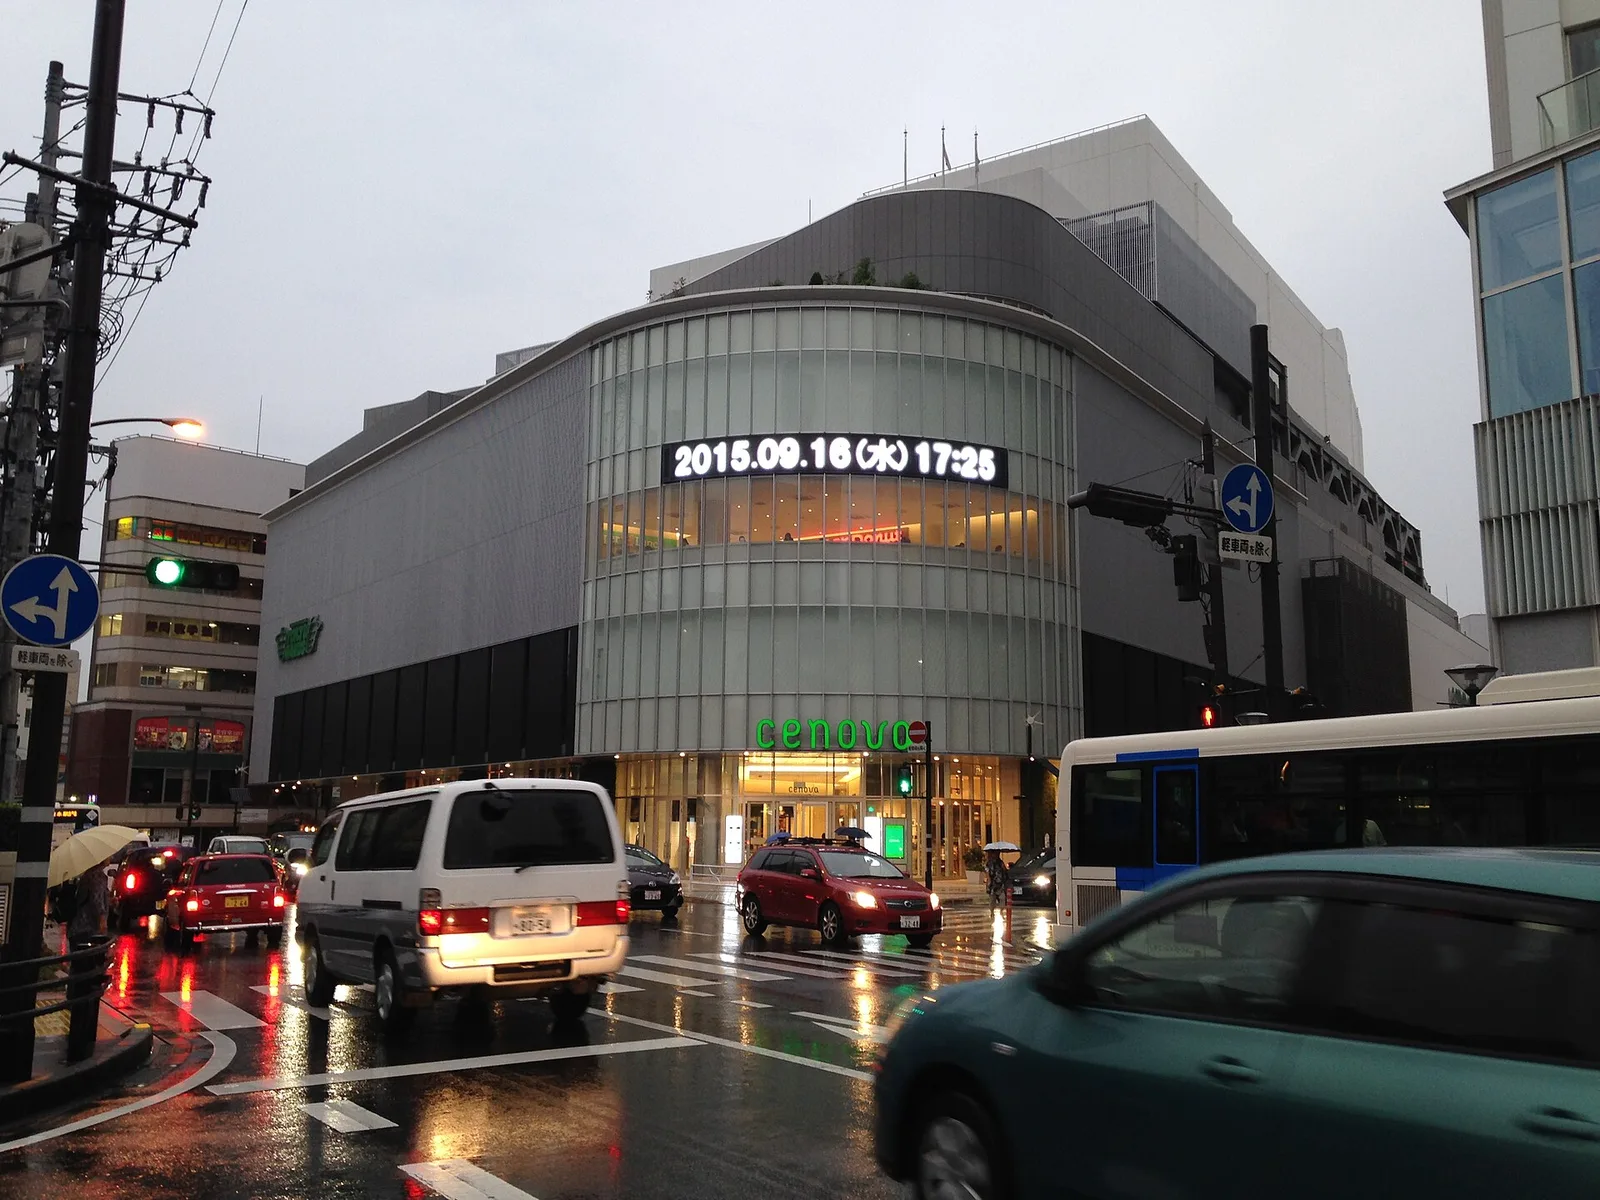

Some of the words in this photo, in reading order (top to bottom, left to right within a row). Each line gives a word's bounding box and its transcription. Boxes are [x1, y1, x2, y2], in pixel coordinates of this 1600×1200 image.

[674, 437, 909, 478] 2015.09.16(水)
[914, 441, 996, 482] 17:25
[1221, 536, 1270, 557] 軽車両を除く
[17, 650, 74, 668] 軽車両を除く
[756, 718, 912, 750] cenova
